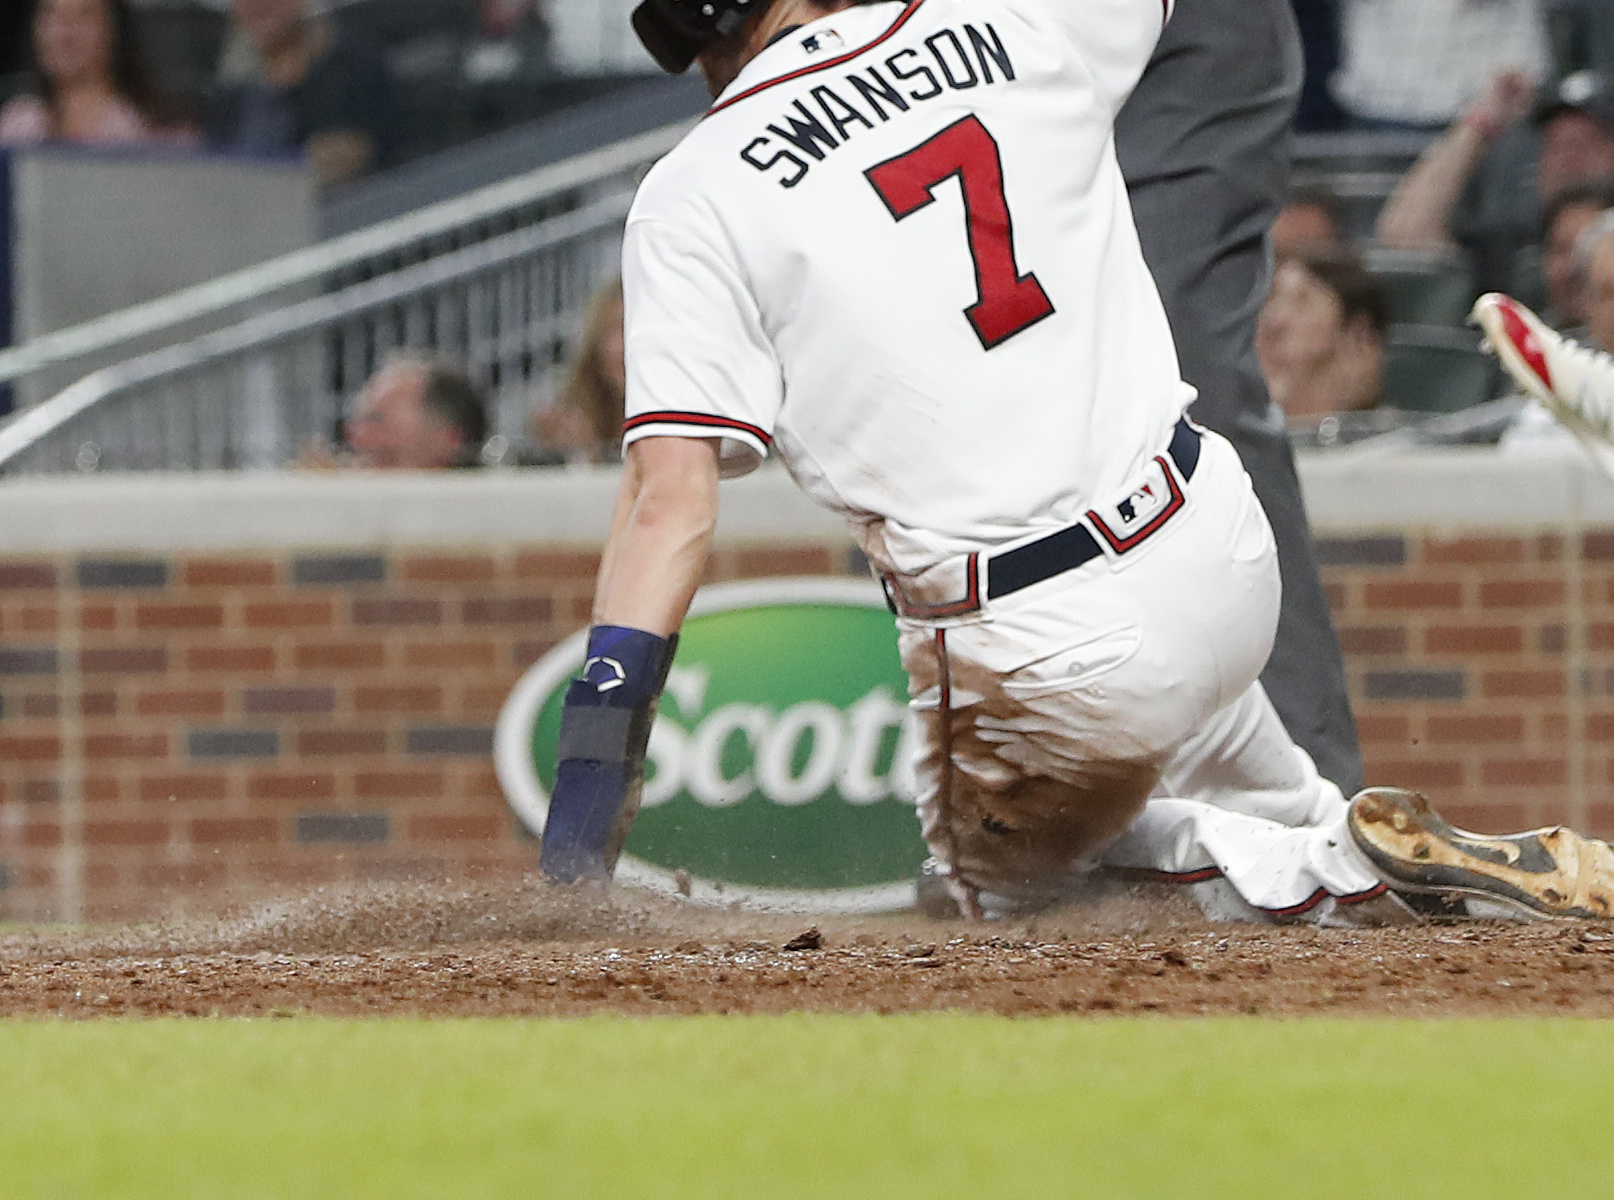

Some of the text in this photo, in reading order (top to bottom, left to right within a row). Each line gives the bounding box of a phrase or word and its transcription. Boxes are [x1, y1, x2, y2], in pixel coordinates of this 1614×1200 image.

[739, 22, 1016, 189] SWANSON
[862, 112, 1056, 352] 7
[636, 662, 920, 806] Scot
